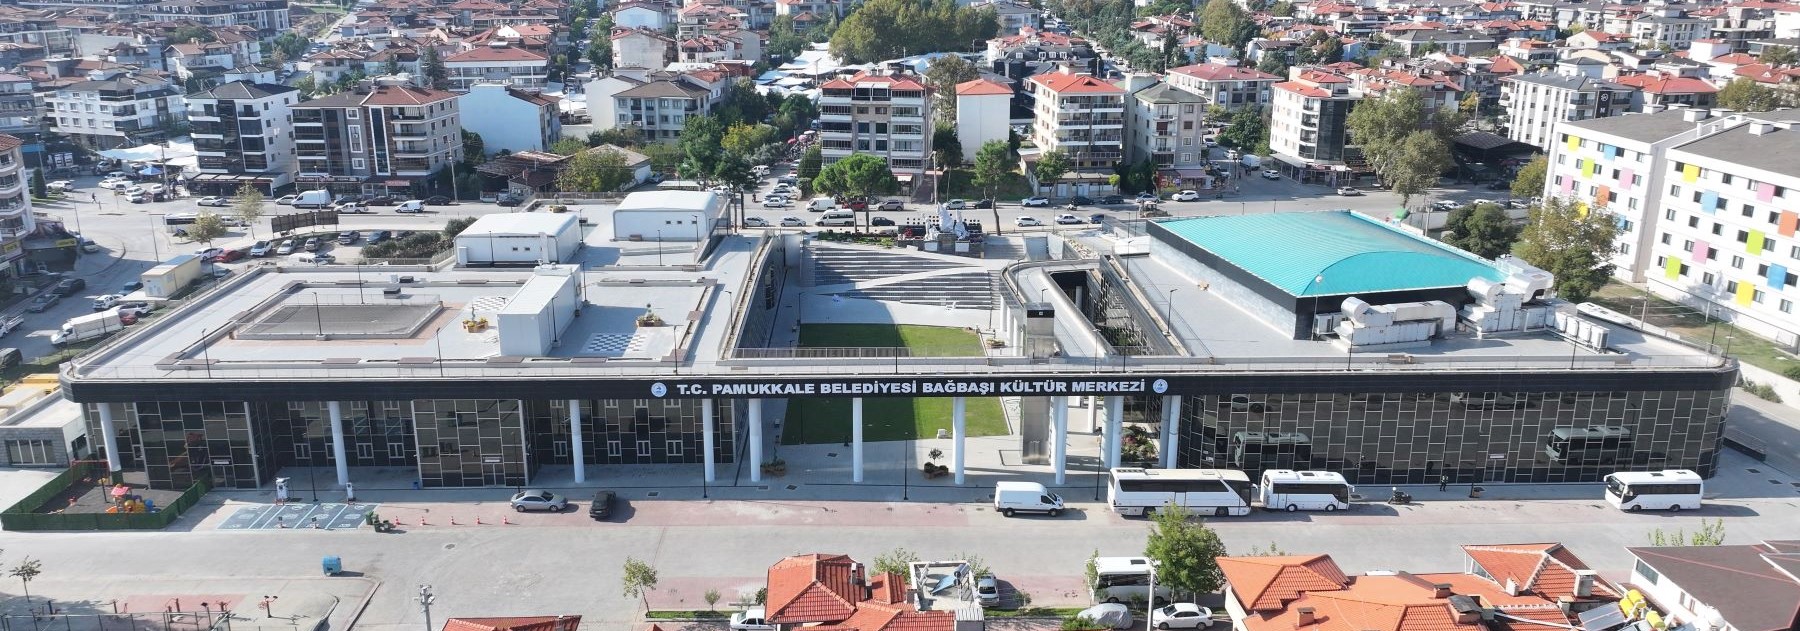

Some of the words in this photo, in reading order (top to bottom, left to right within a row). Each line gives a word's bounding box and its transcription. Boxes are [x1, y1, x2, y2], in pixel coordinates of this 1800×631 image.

[677, 384, 707, 395] T.C.
[712, 383, 815, 395] PAMUKKALE
[820, 380, 917, 394] BELEDİYESİ
[922, 380, 995, 395] BAĞBAŞI
[1000, 379, 1067, 393] KÜLTÜR
[1071, 378, 1145, 393] MERKEZİ
